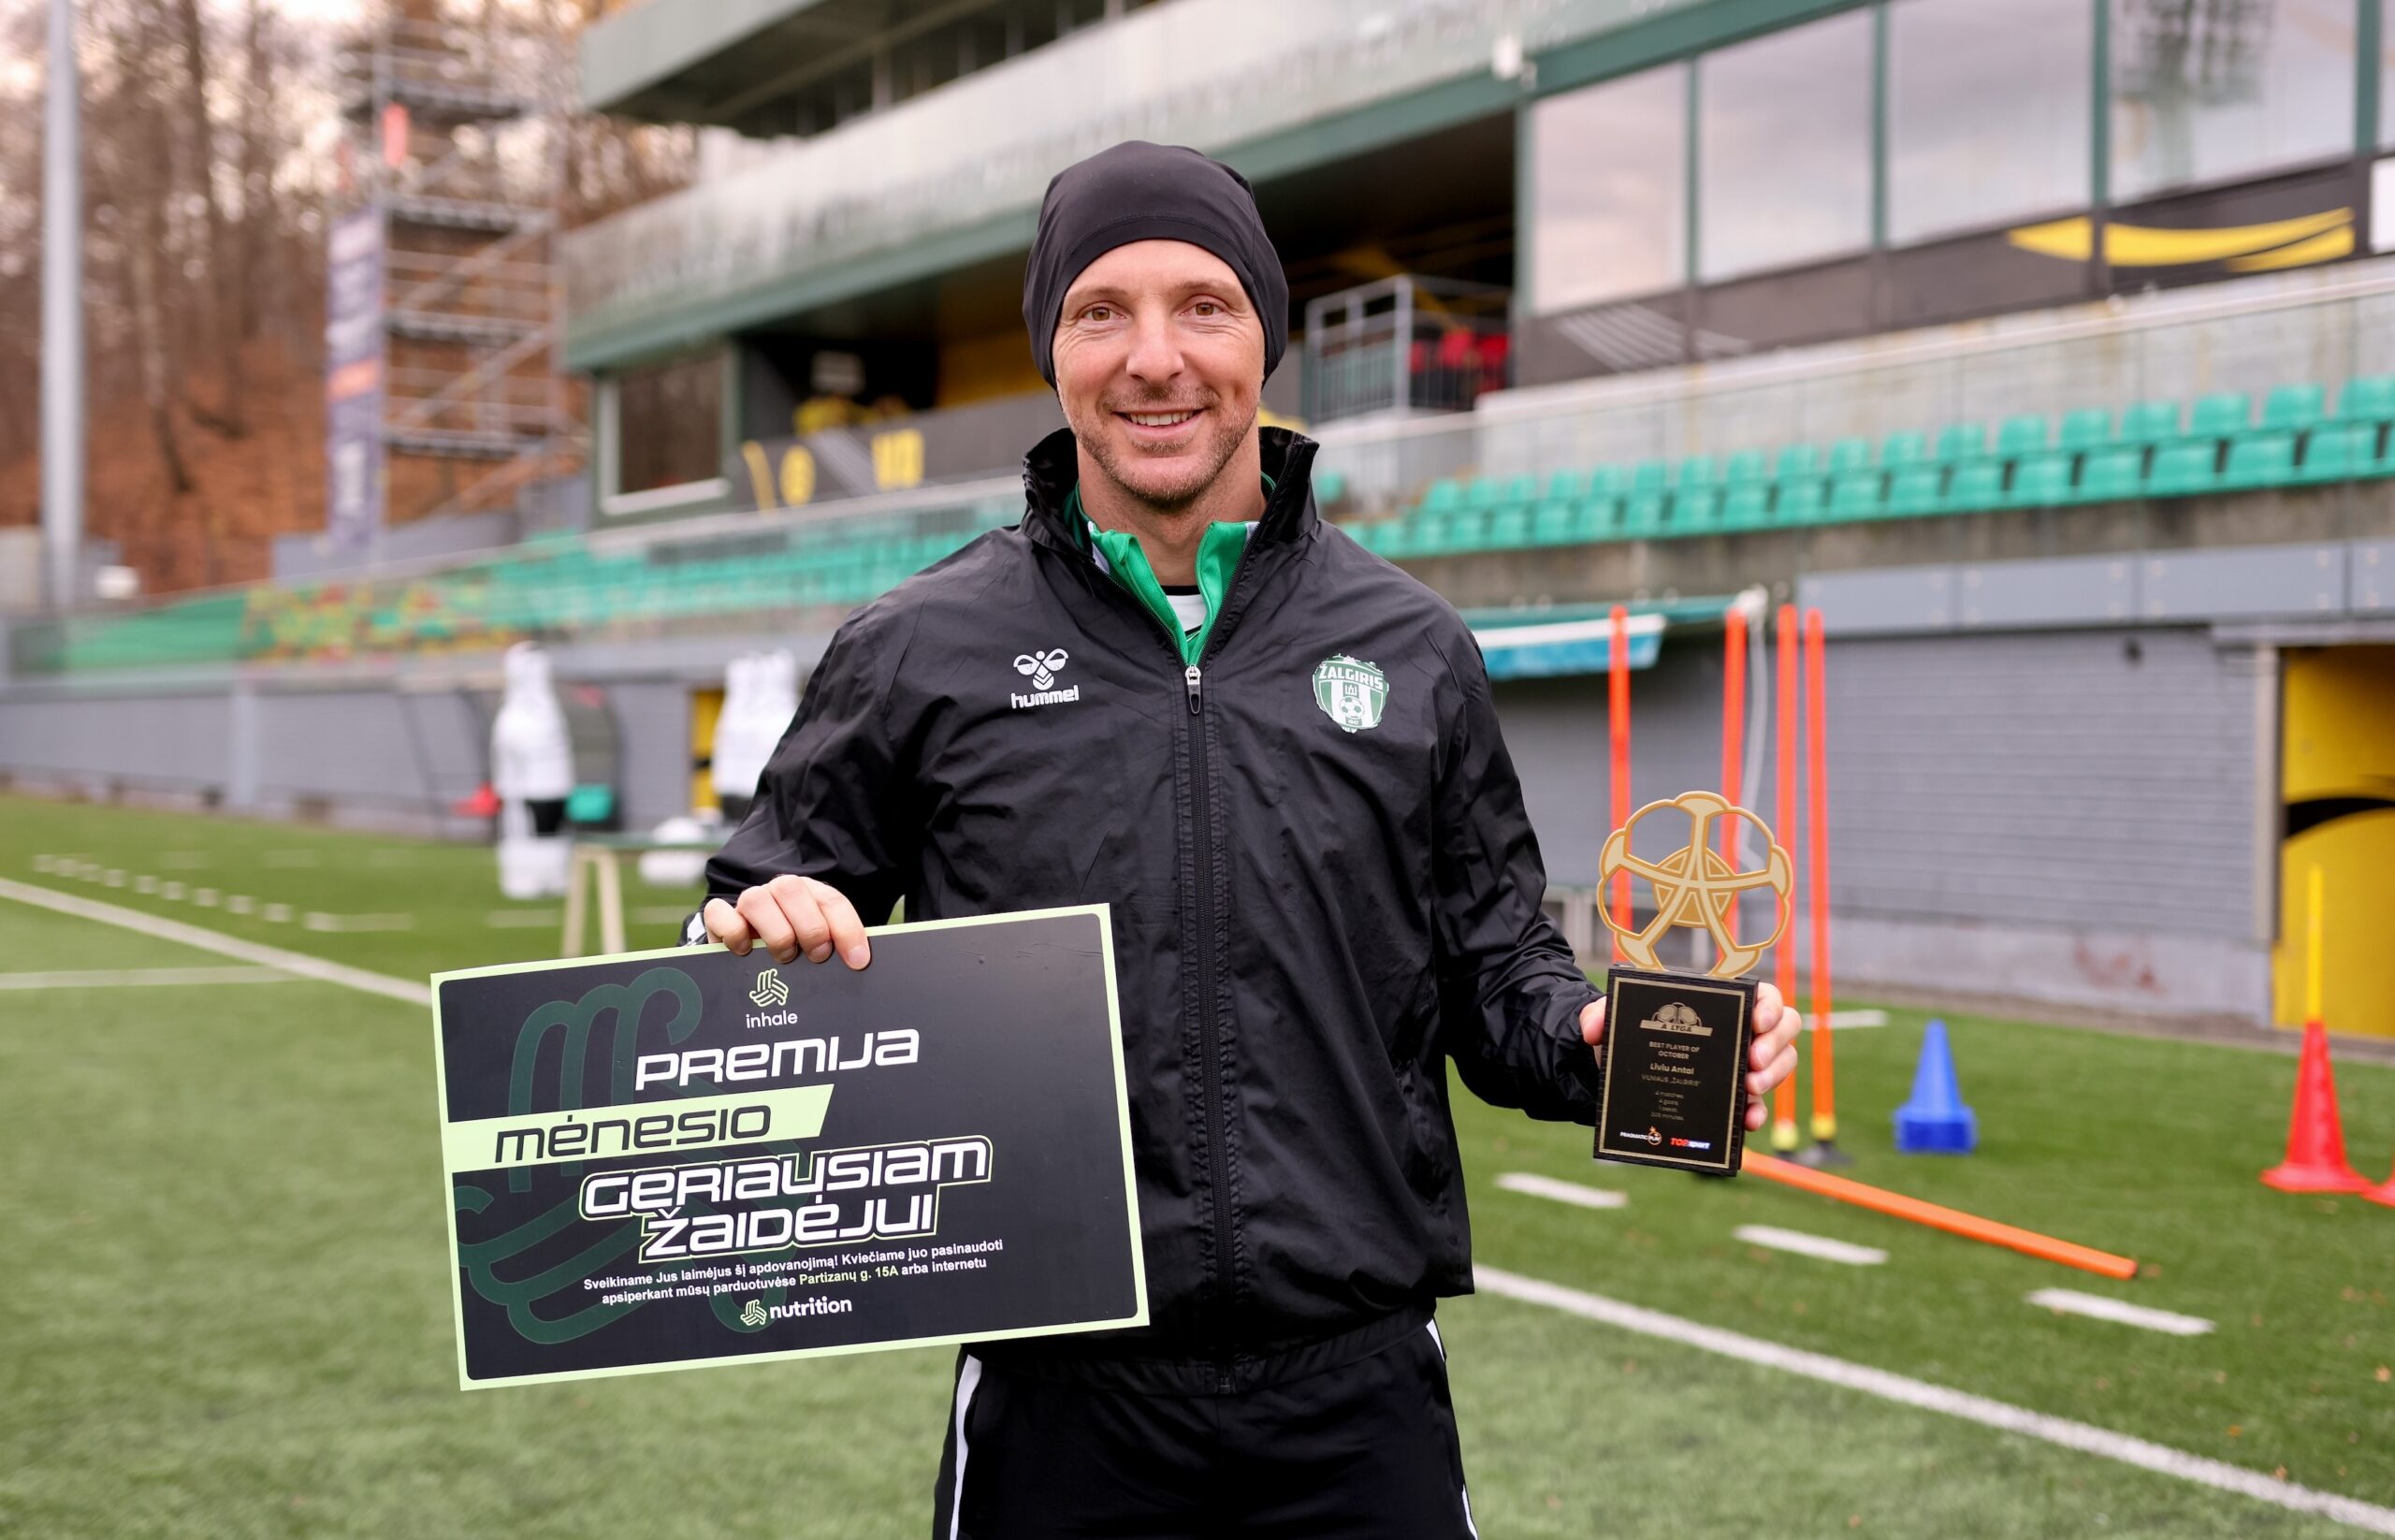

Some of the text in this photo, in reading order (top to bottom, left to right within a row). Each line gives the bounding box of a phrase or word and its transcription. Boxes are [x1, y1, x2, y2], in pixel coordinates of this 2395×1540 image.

[1319, 661, 1384, 690] ŽALGIRIS
[1010, 684, 1080, 709] hummel
[746, 1010, 798, 1028] inhale
[1648, 1040, 1665, 1049] BEST
[1665, 1043, 1691, 1052] PLAYER
[1658, 1050, 1690, 1059] OCTOBER
[1649, 1062, 1670, 1072] Liviu
[584, 1239, 1004, 1290] Sveikiname Jus laimėjus šį apdovanojimą! Kviečiame juo pasinaudoti
[602, 1257, 987, 1306] apsiperkant mūsų parduotuvėse Partizanų g. 15A arba internetu
[770, 1296, 853, 1319] nutrition
